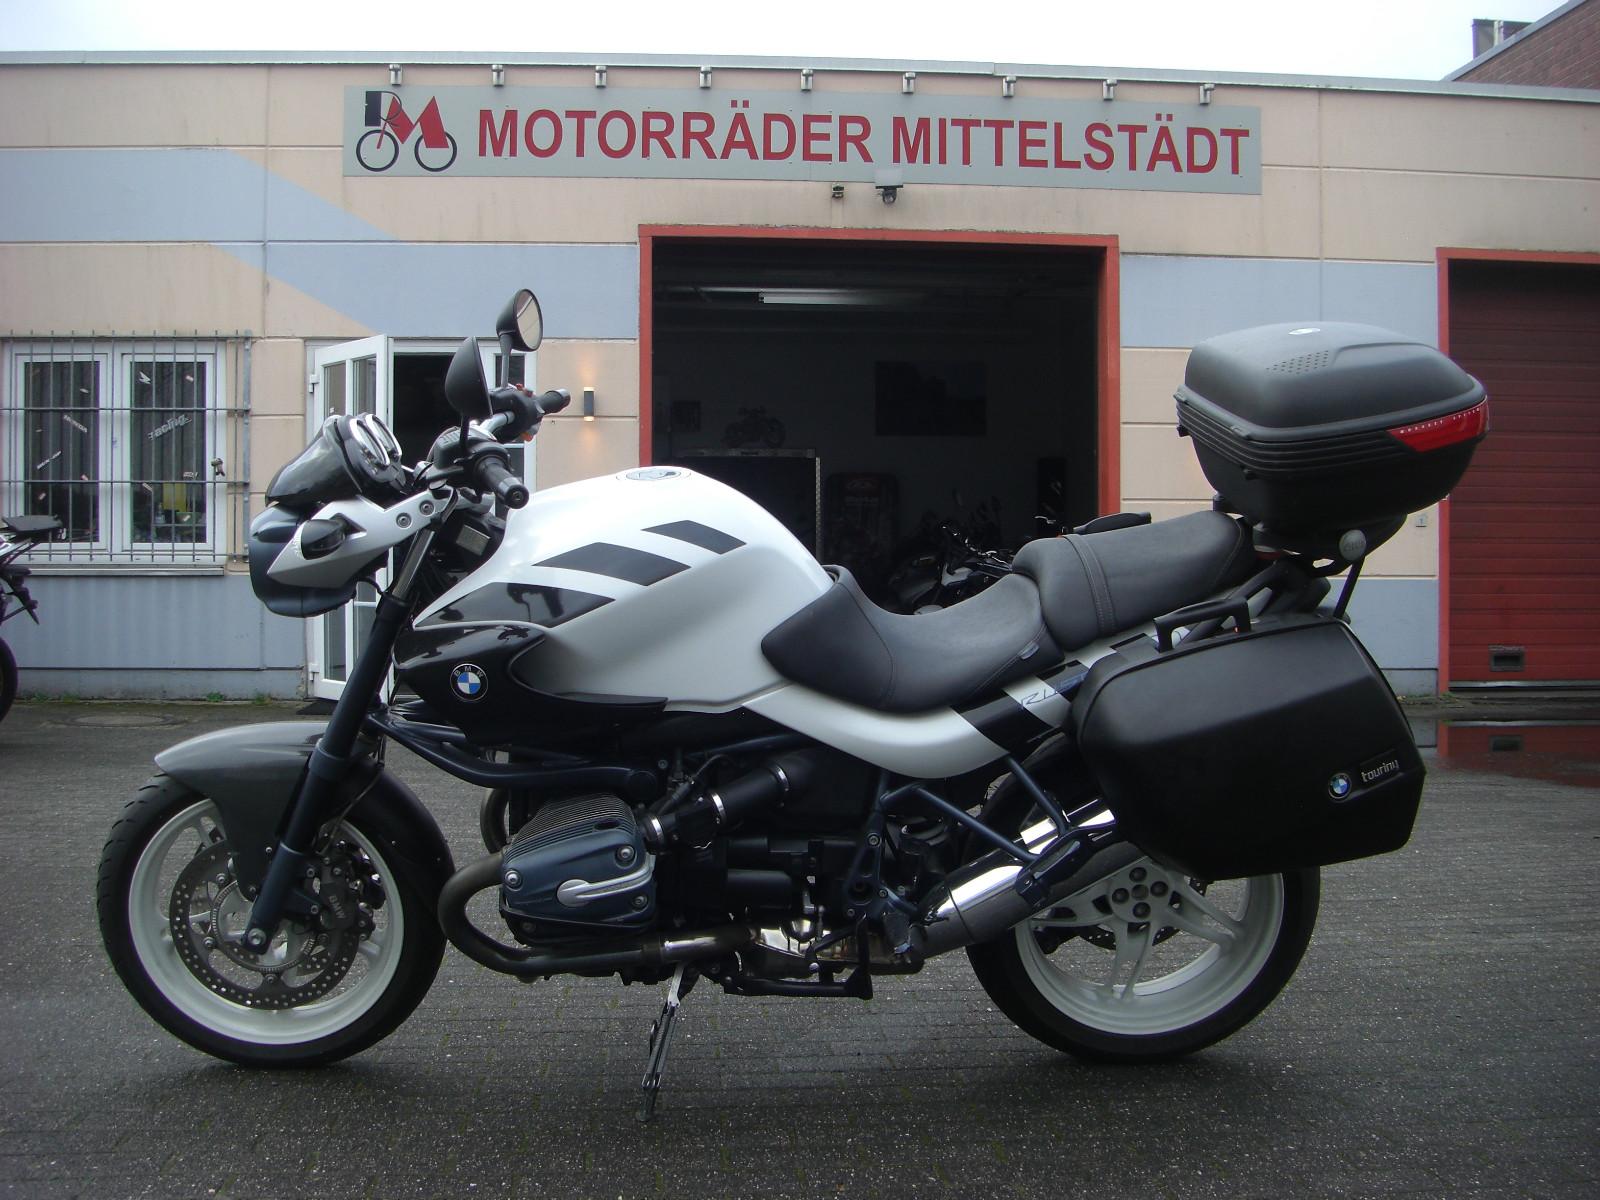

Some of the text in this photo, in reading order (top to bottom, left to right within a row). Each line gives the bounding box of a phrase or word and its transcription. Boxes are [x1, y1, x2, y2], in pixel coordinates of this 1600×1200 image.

[478, 99, 874, 163] MOTORRÄDER
[892, 112, 1250, 175] MITTELSTÄDT
[453, 665, 484, 678] BMW
